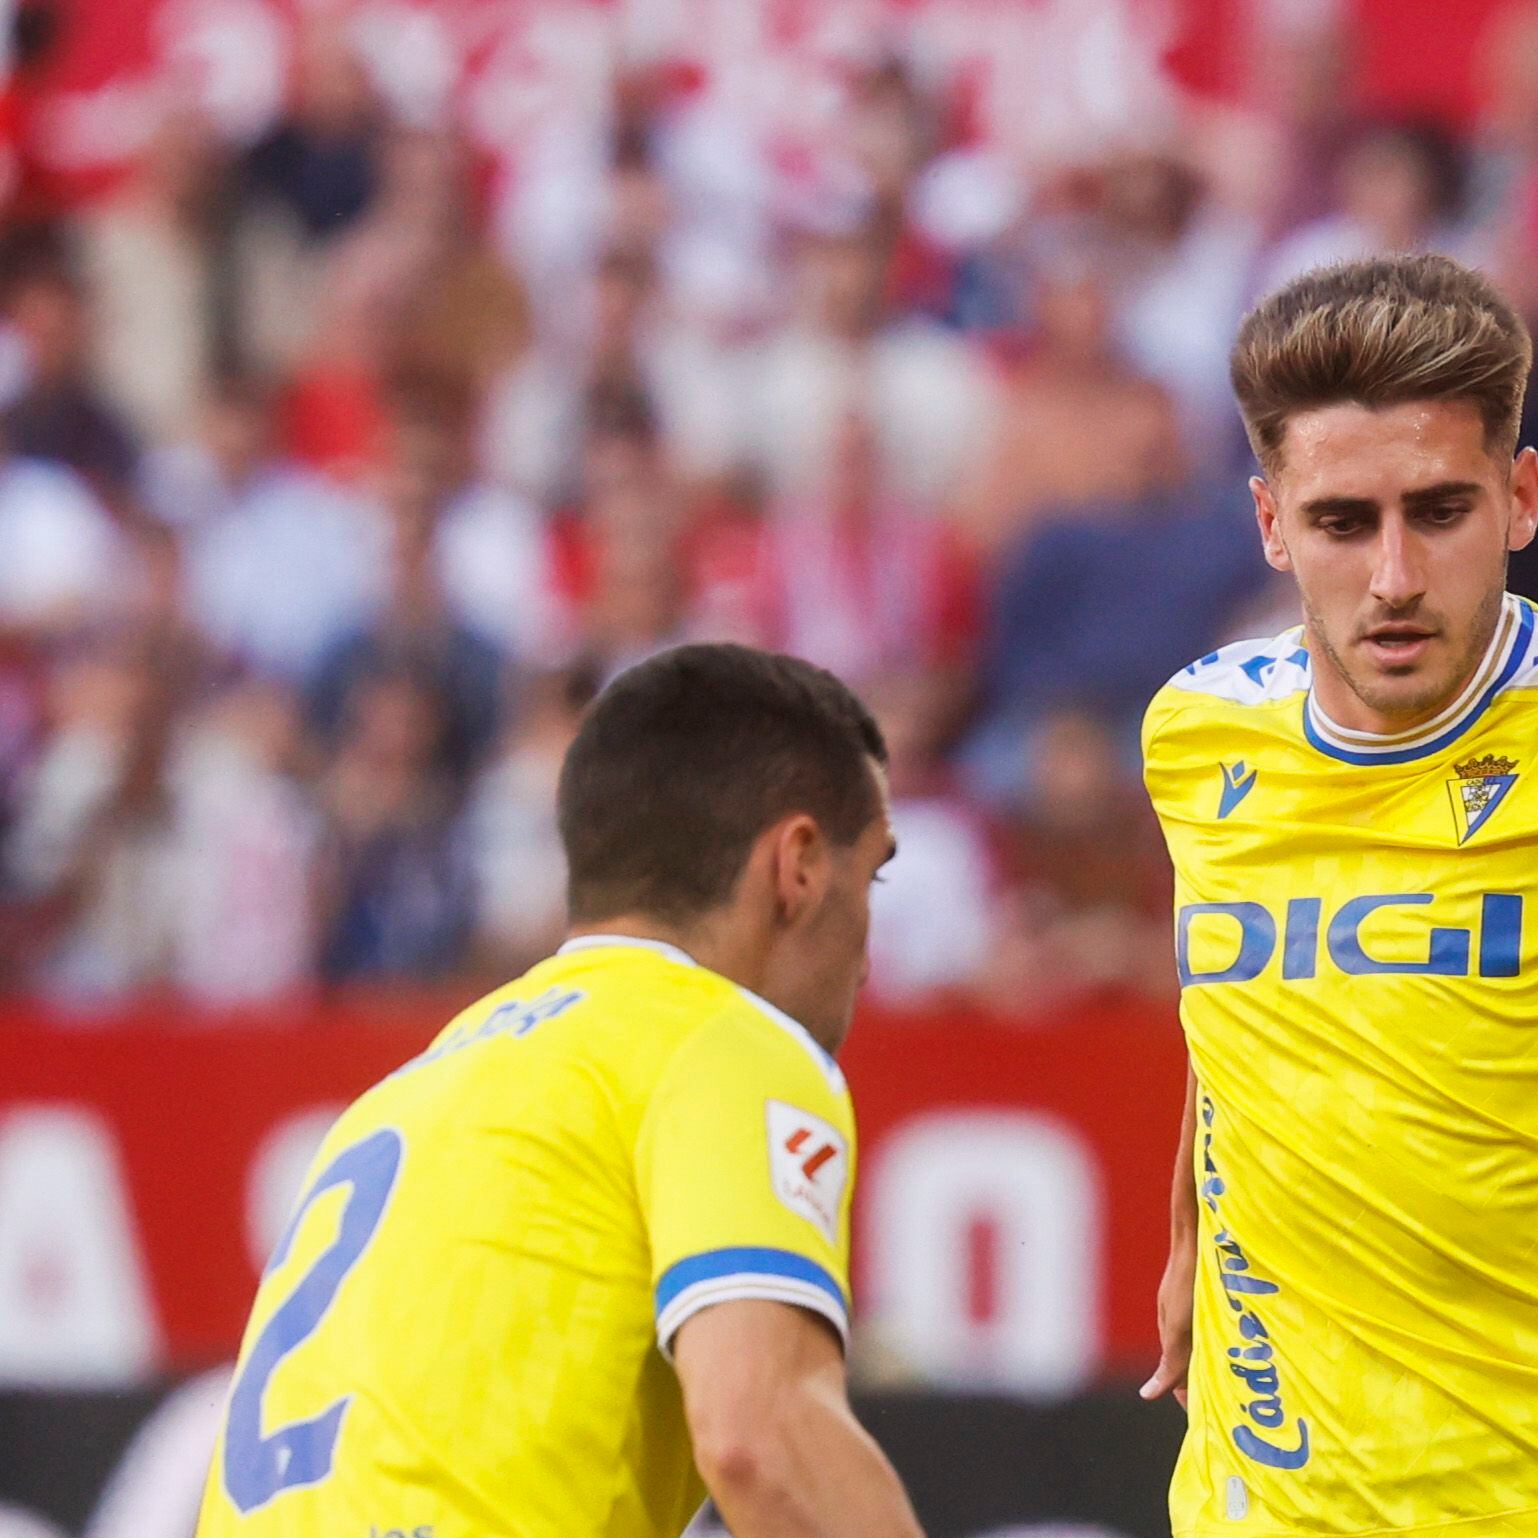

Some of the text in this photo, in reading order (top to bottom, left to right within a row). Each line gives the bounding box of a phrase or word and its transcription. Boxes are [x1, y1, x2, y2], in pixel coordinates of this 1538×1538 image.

[1177, 892, 1523, 987] DIGI
[222, 1125, 407, 1518] 2
[1229, 1309, 1311, 1472] Cádiz
